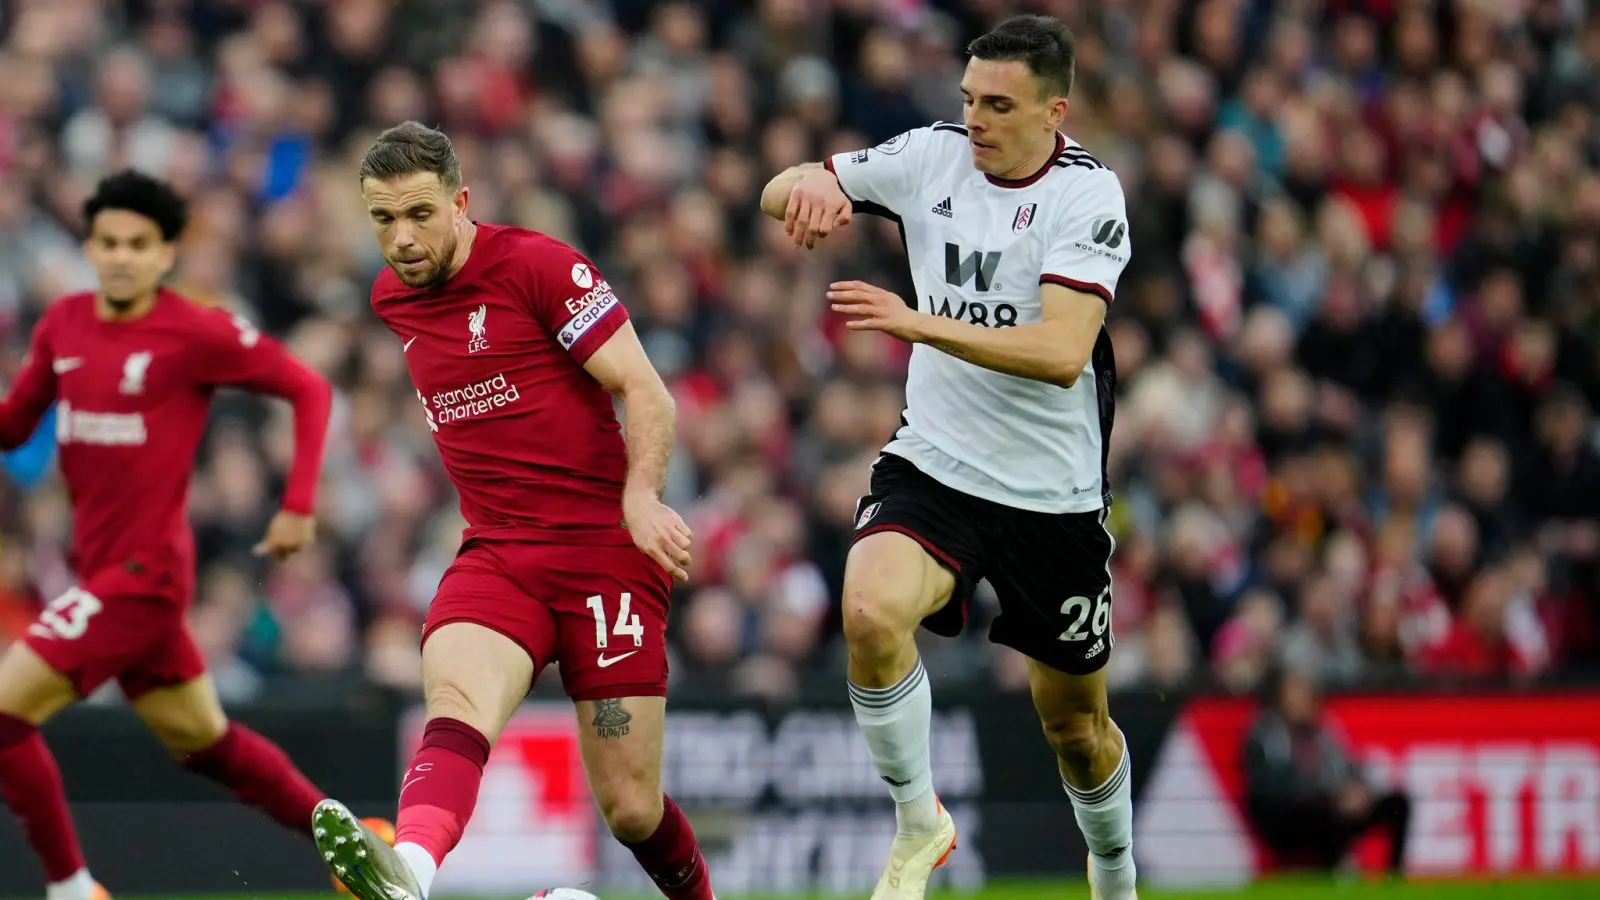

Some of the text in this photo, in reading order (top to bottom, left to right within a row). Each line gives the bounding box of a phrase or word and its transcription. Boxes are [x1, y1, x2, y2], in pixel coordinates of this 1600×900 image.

[931, 206, 954, 219] adidas
[1074, 242, 1126, 265] WORLD MOB
[432, 372, 508, 409] standard
[438, 384, 521, 424] chartered
[586, 592, 645, 648] 14
[1055, 584, 1109, 642] 26
[596, 724, 630, 741] 01/06/19
